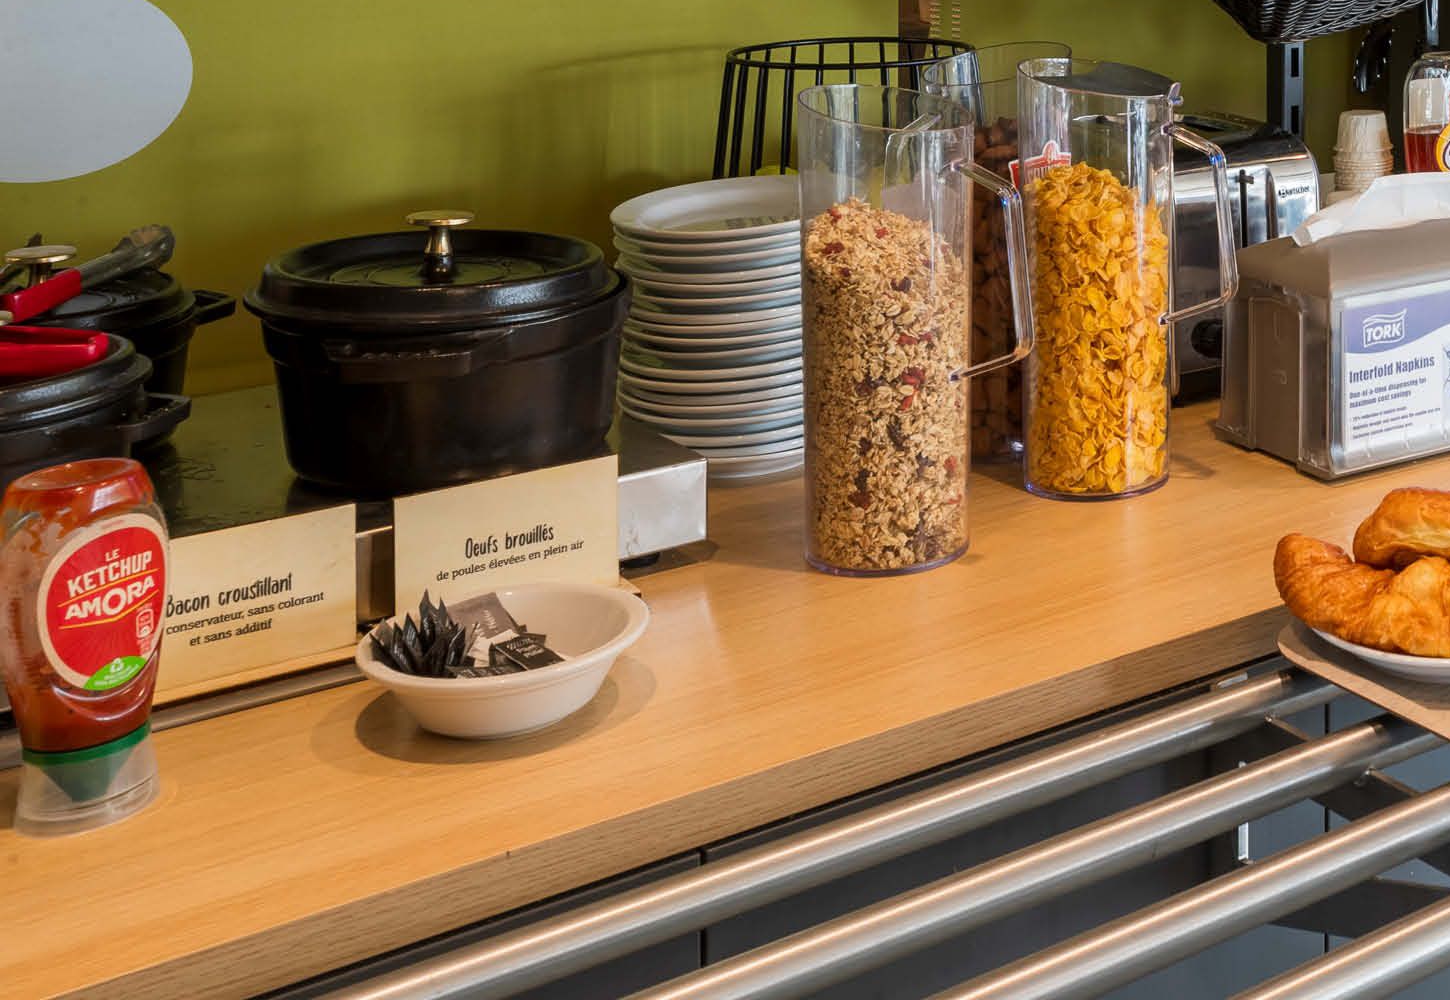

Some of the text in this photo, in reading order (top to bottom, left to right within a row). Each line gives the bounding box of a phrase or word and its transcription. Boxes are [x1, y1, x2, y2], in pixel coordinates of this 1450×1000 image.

[1365, 323, 1402, 342] TORK
[1349, 356, 1436, 384] Interfold Napkins
[105, 548, 121, 562] LE
[436, 539, 585, 582] de poules élevées en plein air
[465, 523, 554, 559] Oeufs brouillés
[67, 550, 153, 598] KETCHUP
[64, 575, 155, 620] AMORA
[165, 572, 293, 618] Bacon croustillant
[166, 592, 325, 636] conservateur, sans colorant
[189, 618, 273, 647] et sans additif
